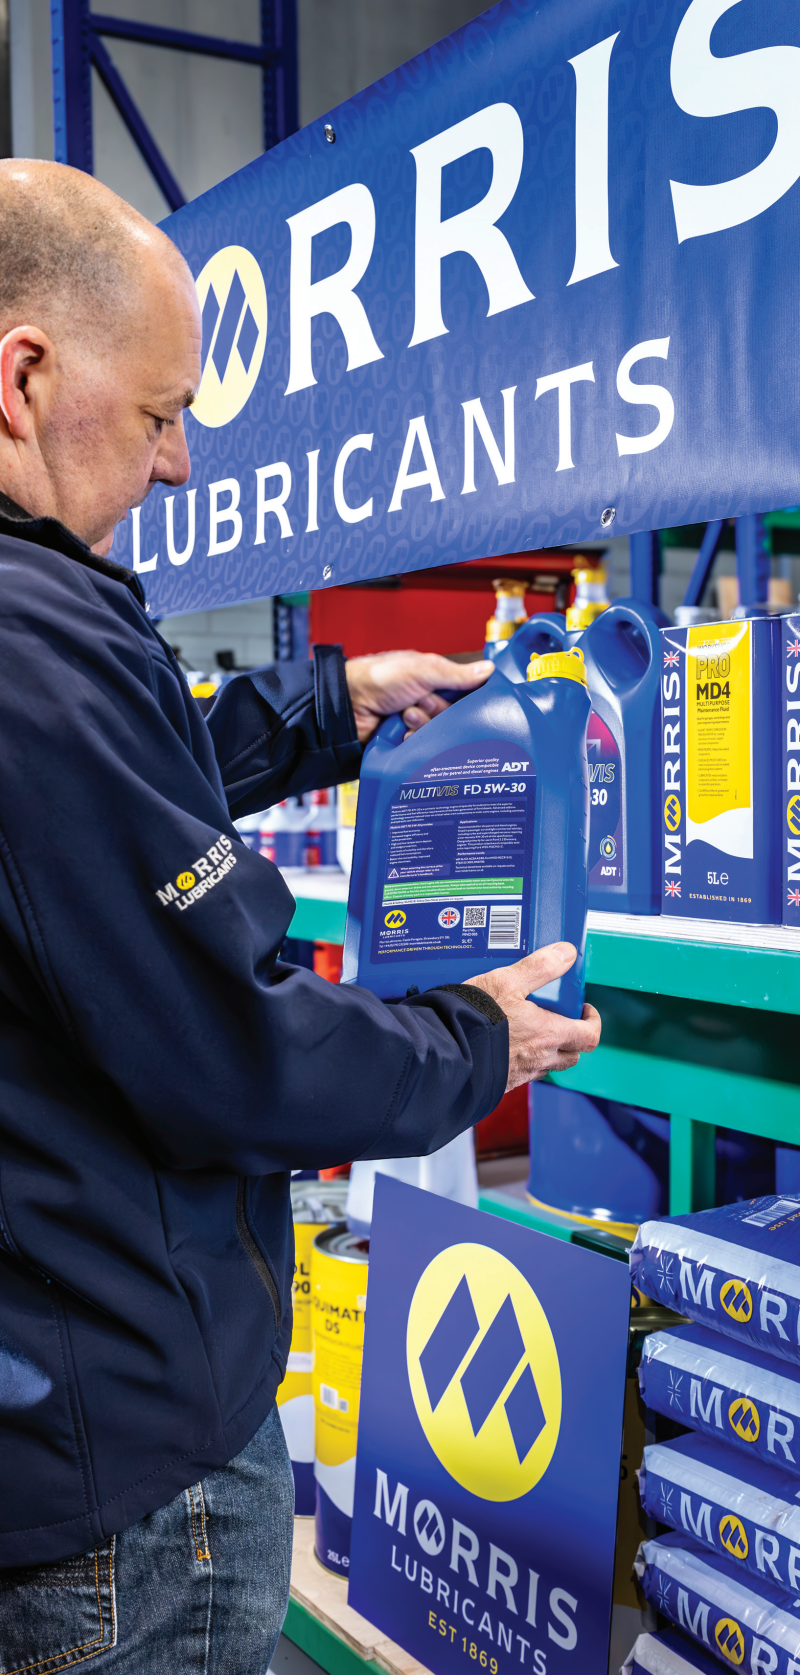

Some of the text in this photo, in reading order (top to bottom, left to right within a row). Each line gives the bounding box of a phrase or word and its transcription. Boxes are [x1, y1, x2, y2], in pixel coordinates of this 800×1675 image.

[131, 335, 675, 574] LUBRICANTS
[696, 652, 730, 680] PRO
[696, 681, 731, 700] MD4
[501, 761, 529, 772] ADT
[663, 671, 682, 876] MORRIS
[399, 782, 527, 800] MULTIVIS FD 5W-30
[155, 834, 233, 907] MORRIS
[174, 852, 238, 911] LUBRICANTS
[600, 866, 617, 876] ADT
[689, 893, 727, 902] ESTABLISHED
[379, 928, 409, 937] MORRIS
[679, 1261, 800, 1346] MOR
[325, 1319, 340, 1334] DS
[373, 1468, 578, 1651] MORRIS
[391, 1545, 547, 1675] LUBRICANTS
[428, 1610, 498, 1675] EST 1869
